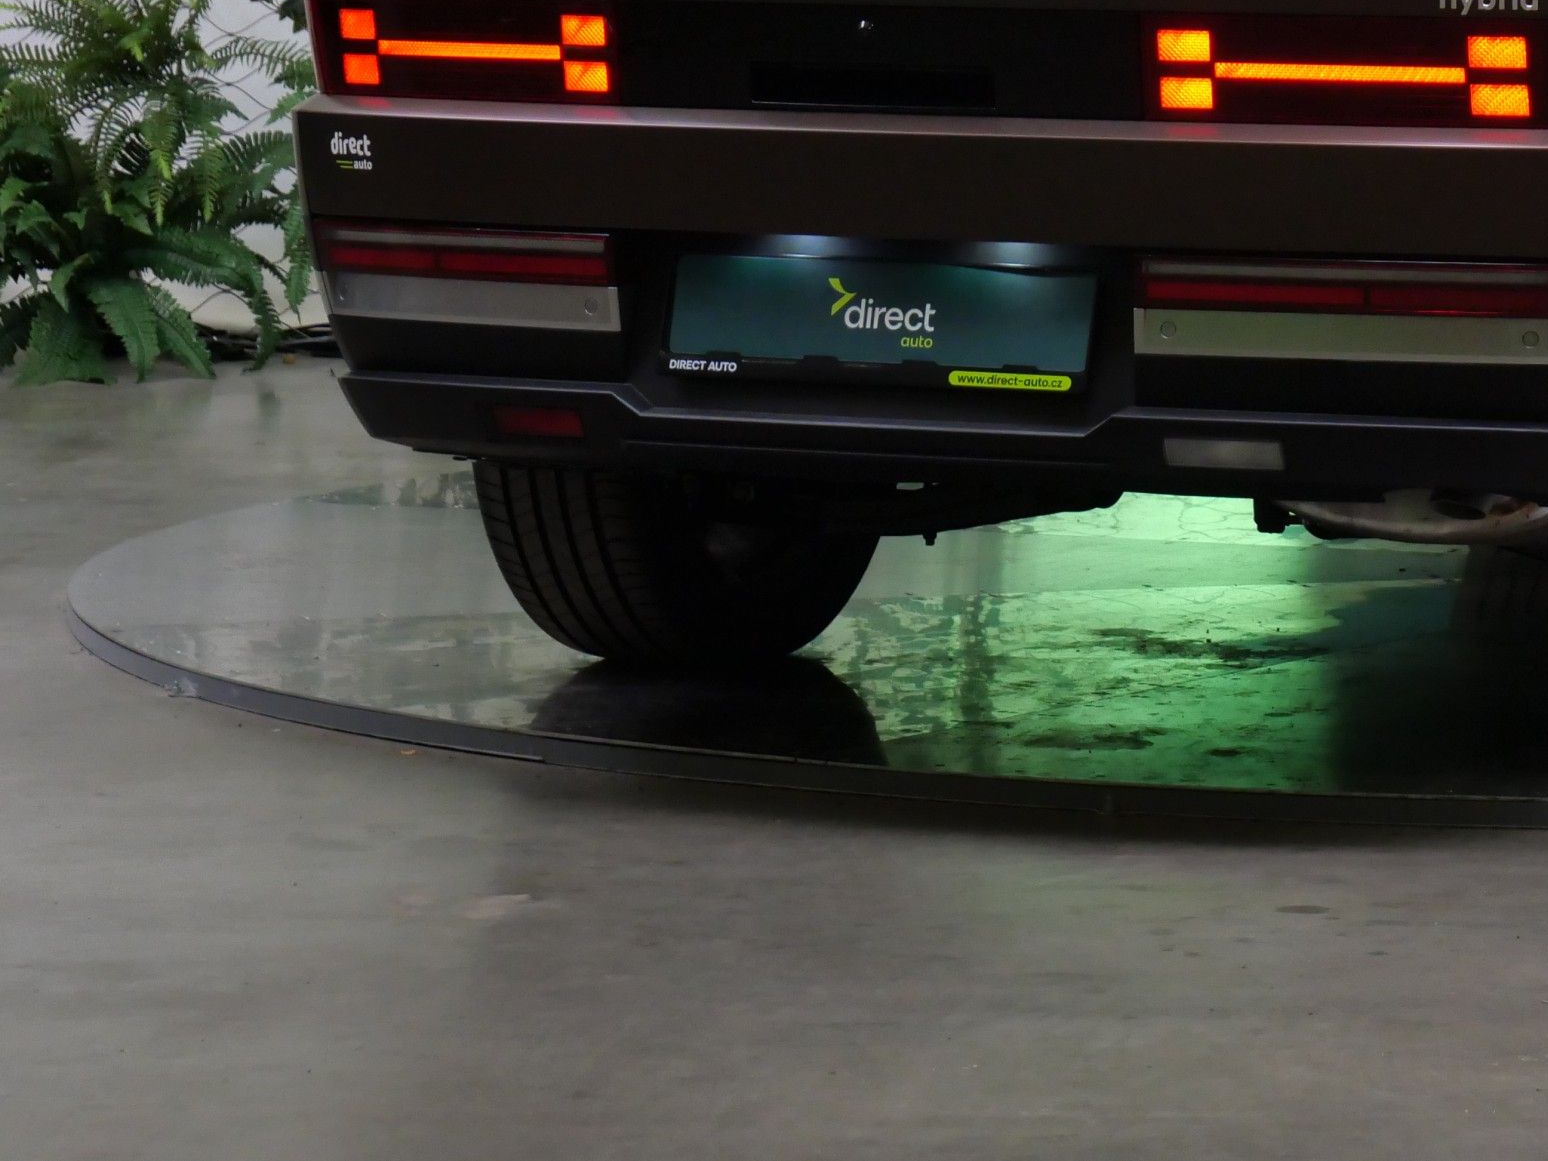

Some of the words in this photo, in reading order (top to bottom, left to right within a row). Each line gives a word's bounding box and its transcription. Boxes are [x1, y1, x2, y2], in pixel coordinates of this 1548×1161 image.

[330, 131, 371, 157] direct
[353, 159, 373, 170] auto
[843, 297, 937, 333] direct
[900, 335, 933, 348] auto
[669, 359, 706, 371] DIRECT
[707, 361, 738, 372] AUTO
[957, 374, 1064, 389] www.direct-auto.cz
